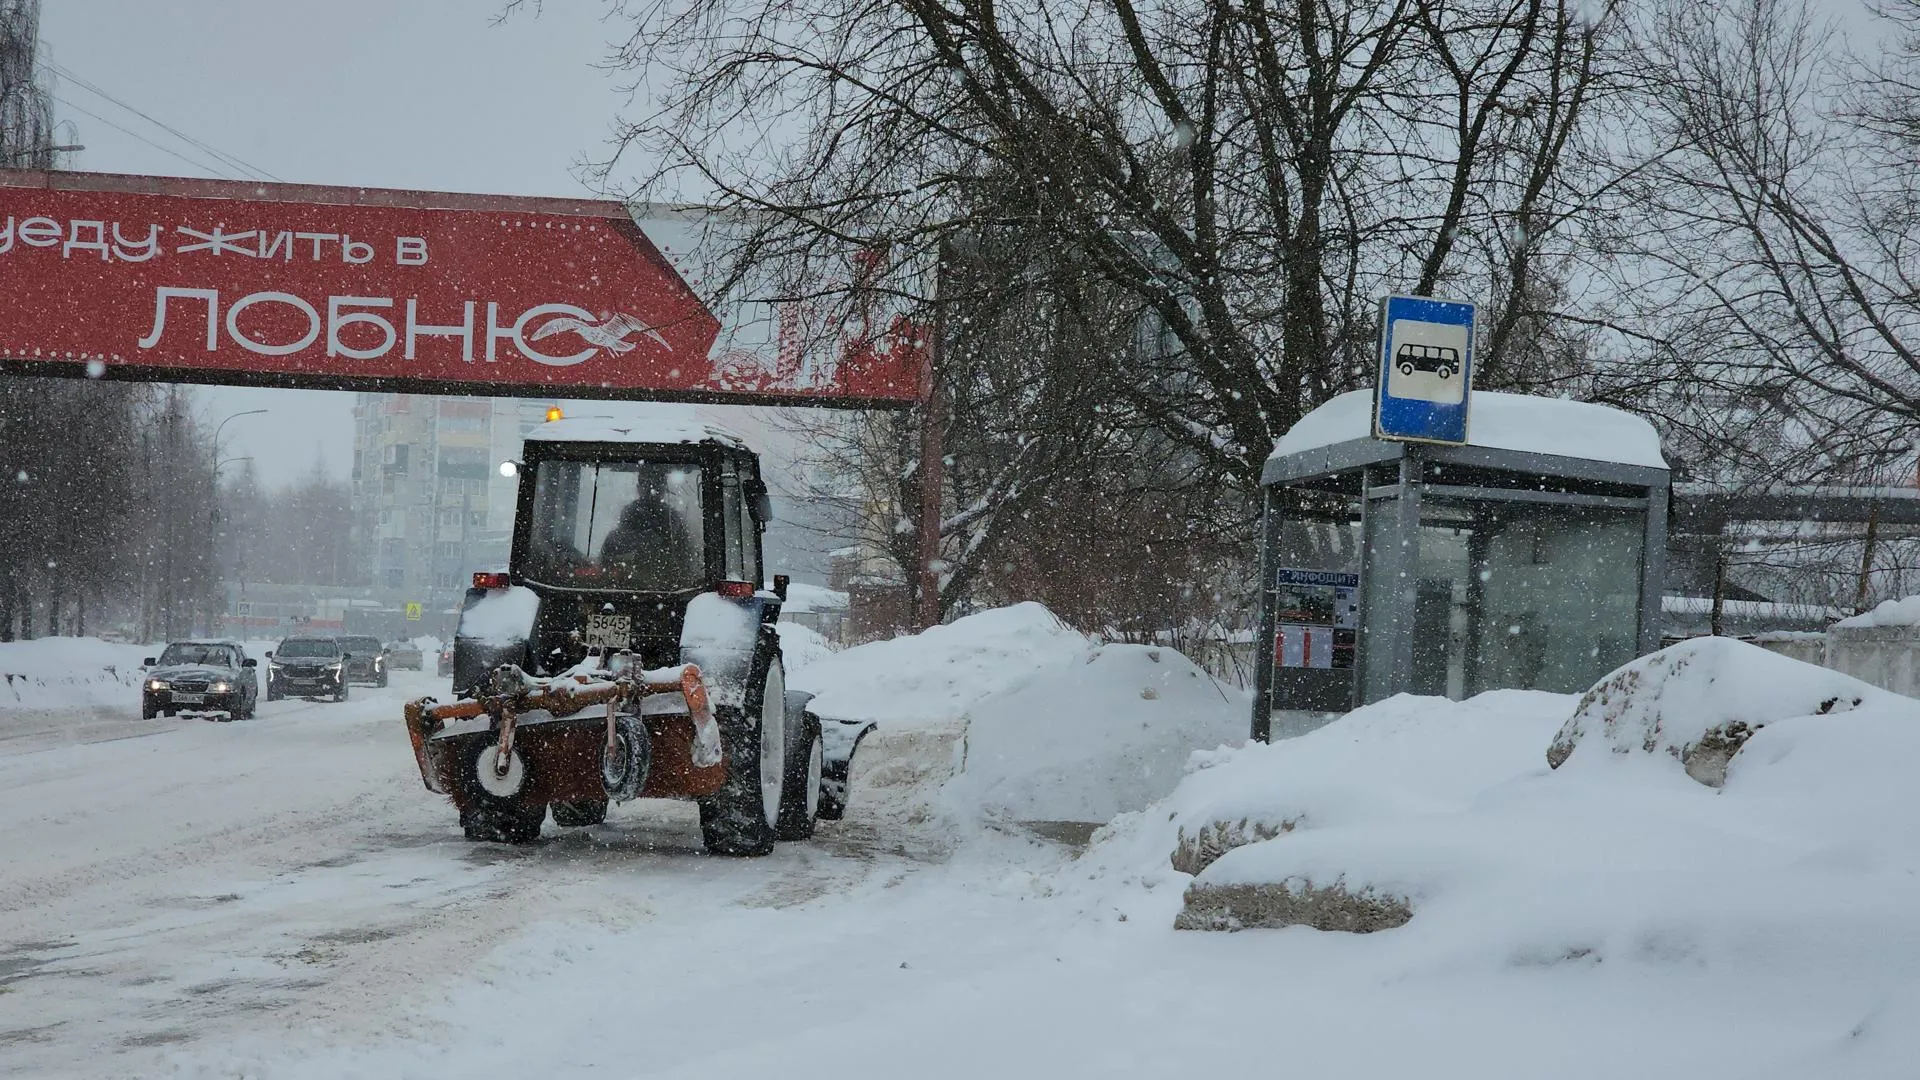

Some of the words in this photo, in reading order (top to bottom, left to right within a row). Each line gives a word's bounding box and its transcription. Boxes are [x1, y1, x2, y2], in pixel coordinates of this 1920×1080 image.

[176, 225, 375, 264] жить
[396, 236, 429, 266] в
[137, 286, 604, 367] ЛОБНЮ
[1291, 570, 1353, 585] ИНФОЩИТ
[593, 615, 626, 630] 5845
